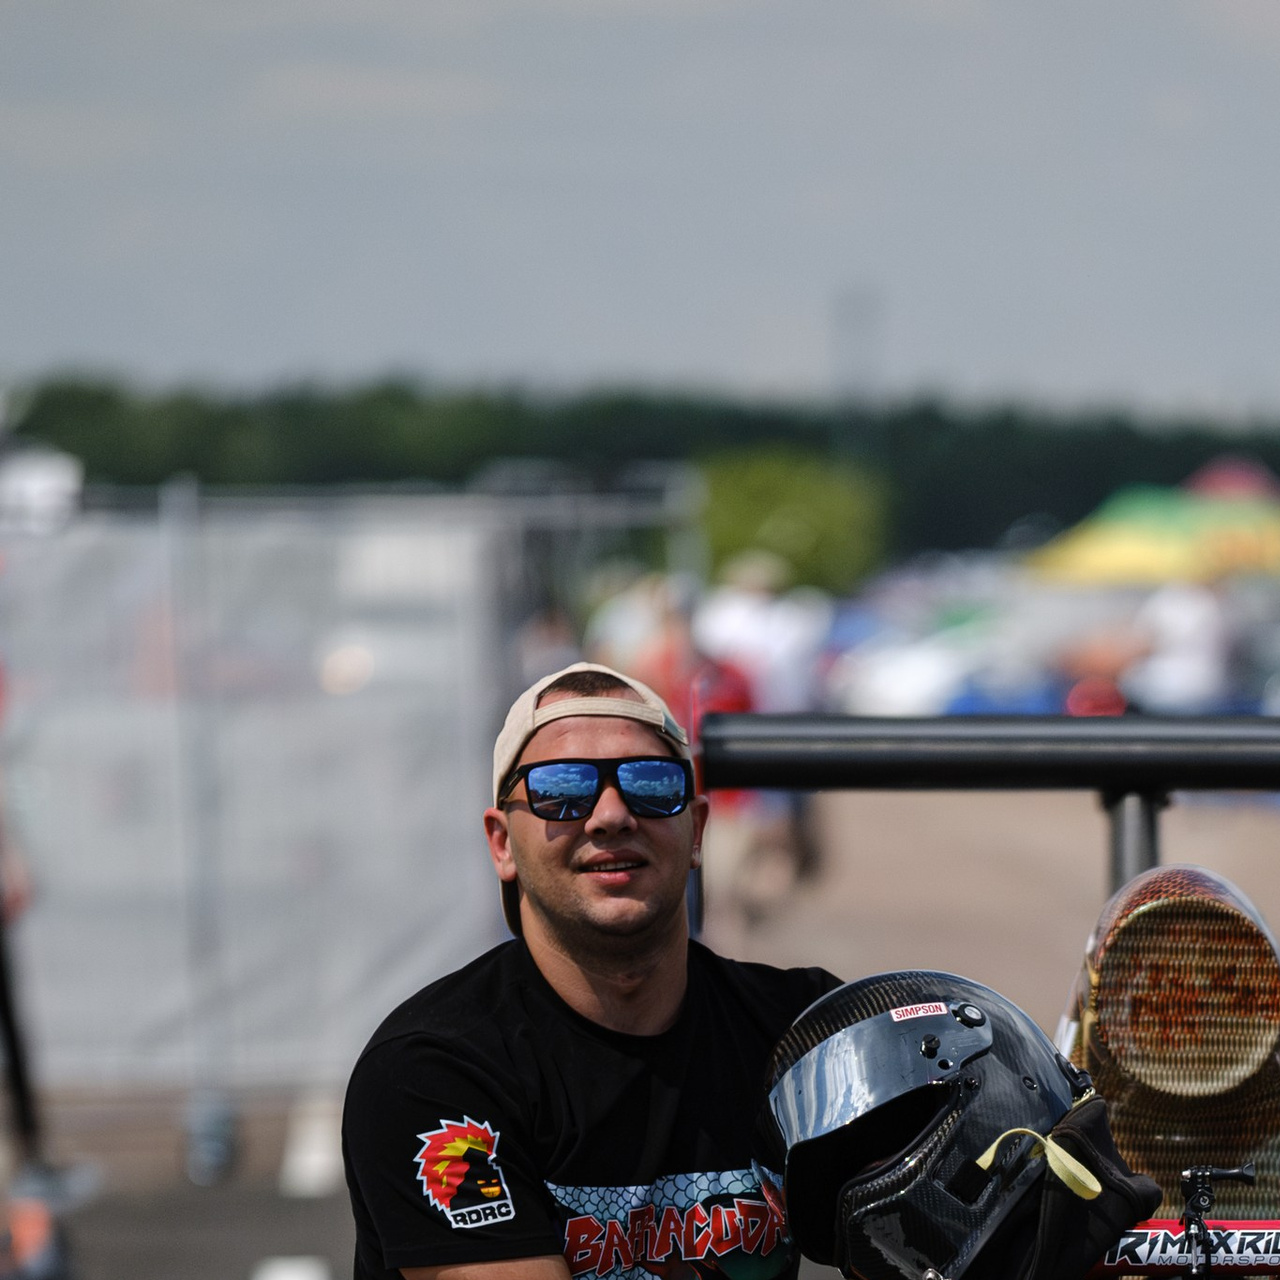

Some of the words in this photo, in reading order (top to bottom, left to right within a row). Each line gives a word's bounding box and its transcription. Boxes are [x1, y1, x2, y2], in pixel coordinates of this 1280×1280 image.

[894, 1003, 943, 1019] SIMPSON
[451, 1203, 512, 1225] RDRC
[564, 1198, 788, 1277] BARRACUDA
